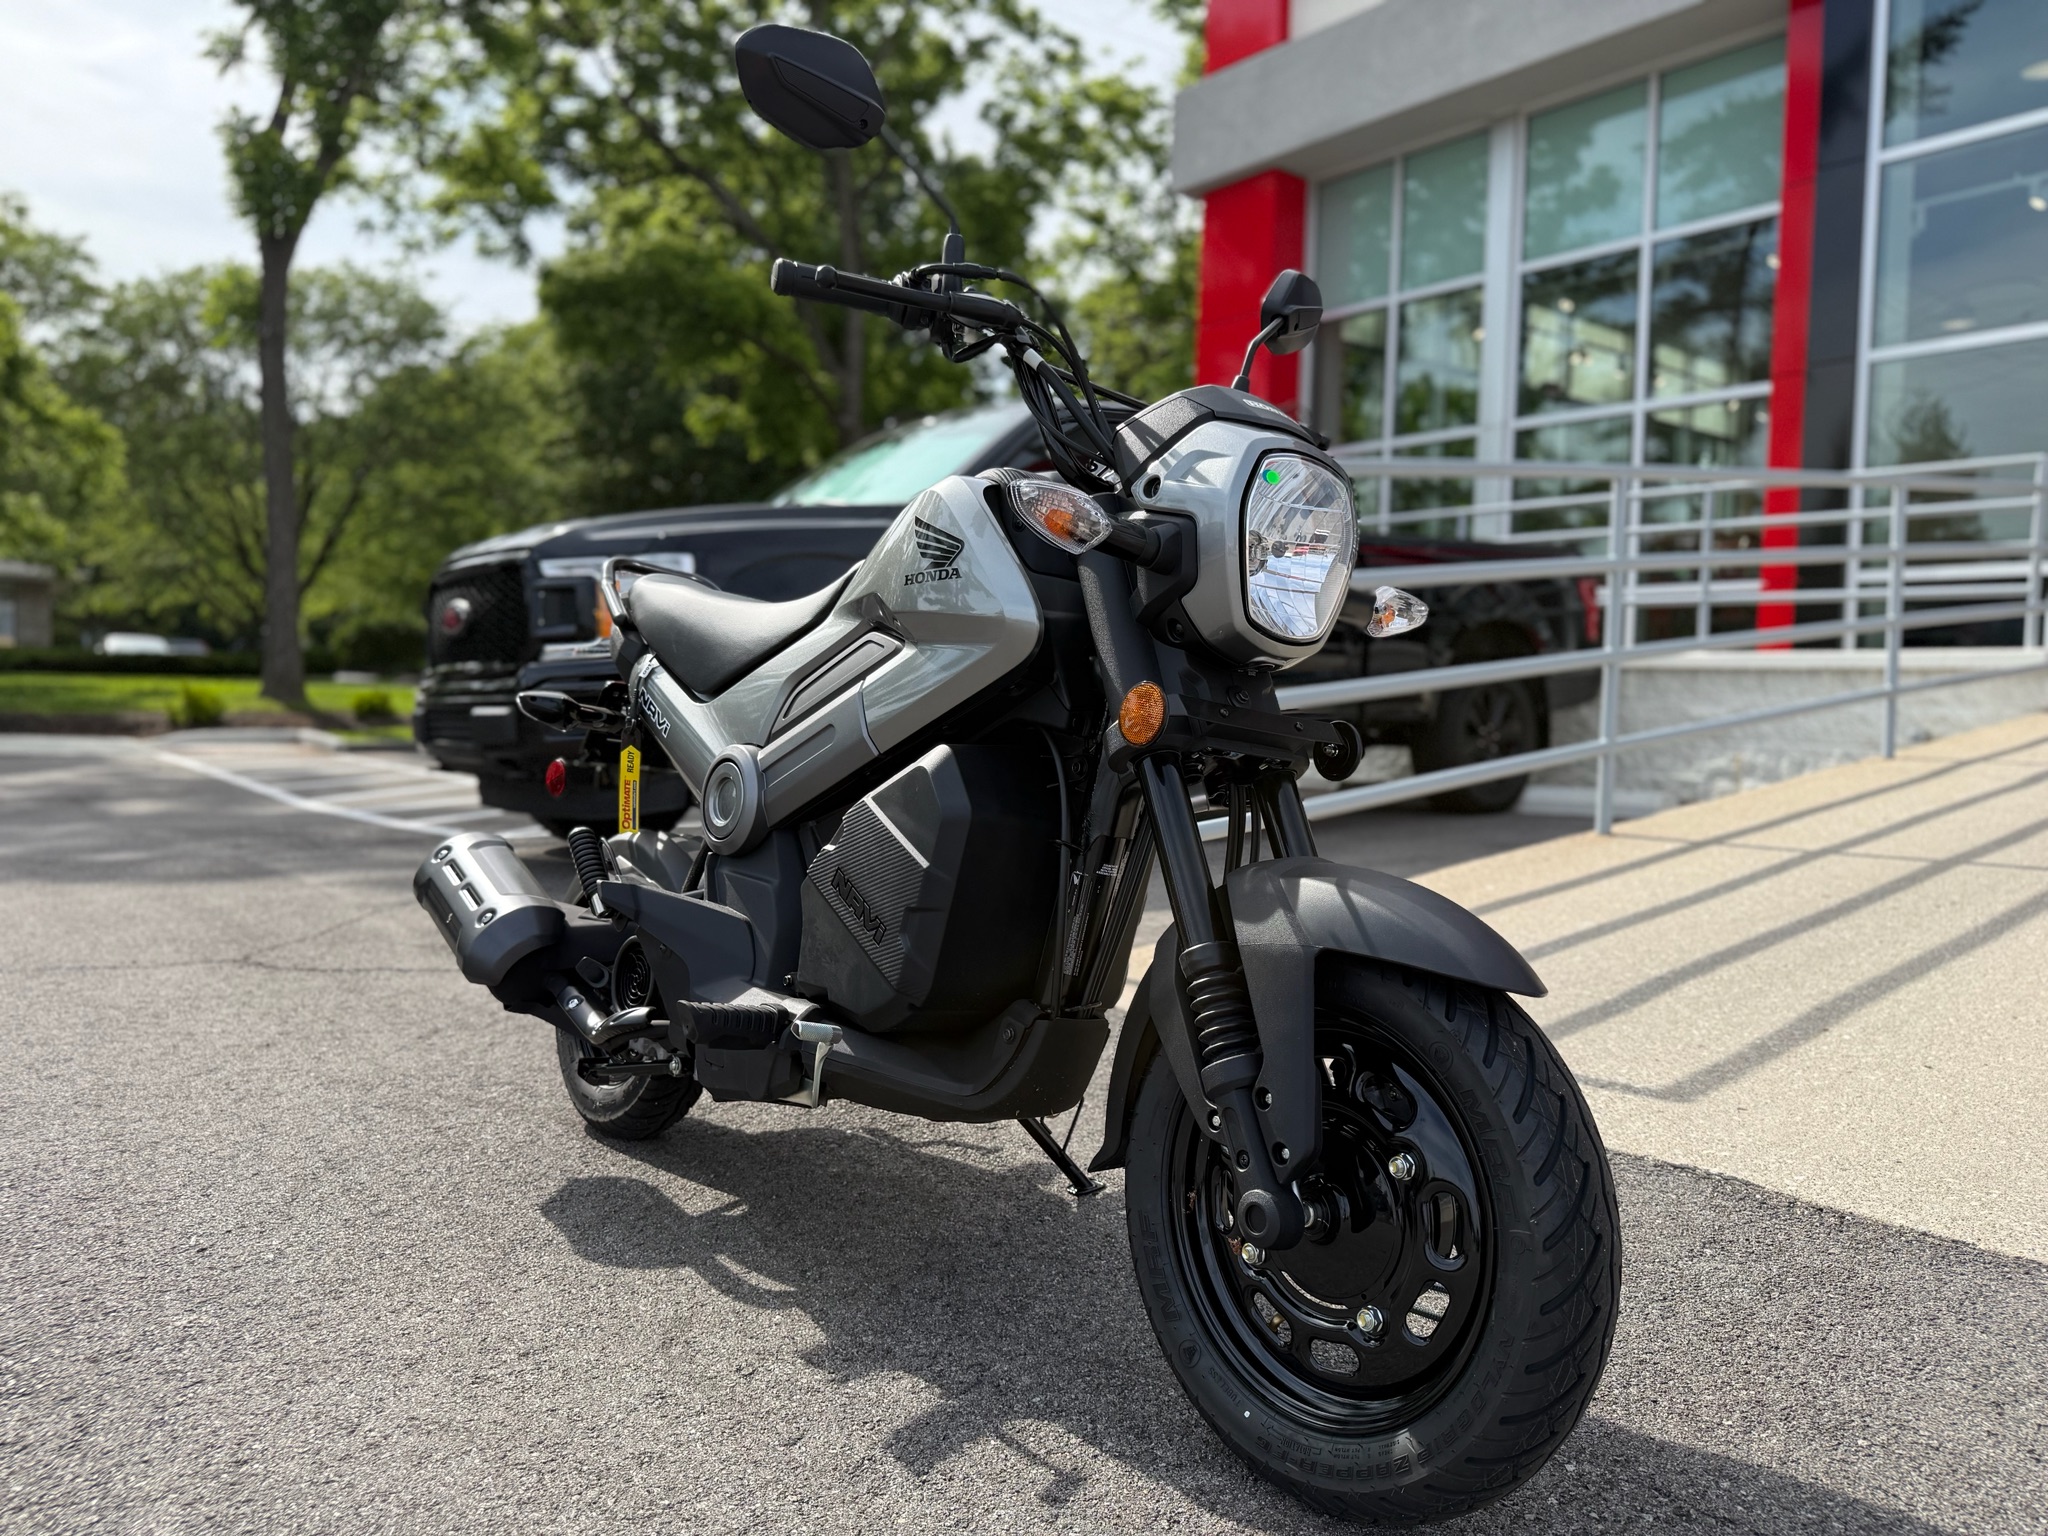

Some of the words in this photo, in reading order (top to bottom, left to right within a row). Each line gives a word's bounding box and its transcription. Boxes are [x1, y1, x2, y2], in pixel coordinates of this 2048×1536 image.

[904, 568, 962, 586] HONDA
[627, 750, 635, 773] READY
[1459, 1089, 1521, 1222] MRF
[1137, 1208, 1182, 1322] MRF
[1207, 1366, 1242, 1408] TUBELESS
